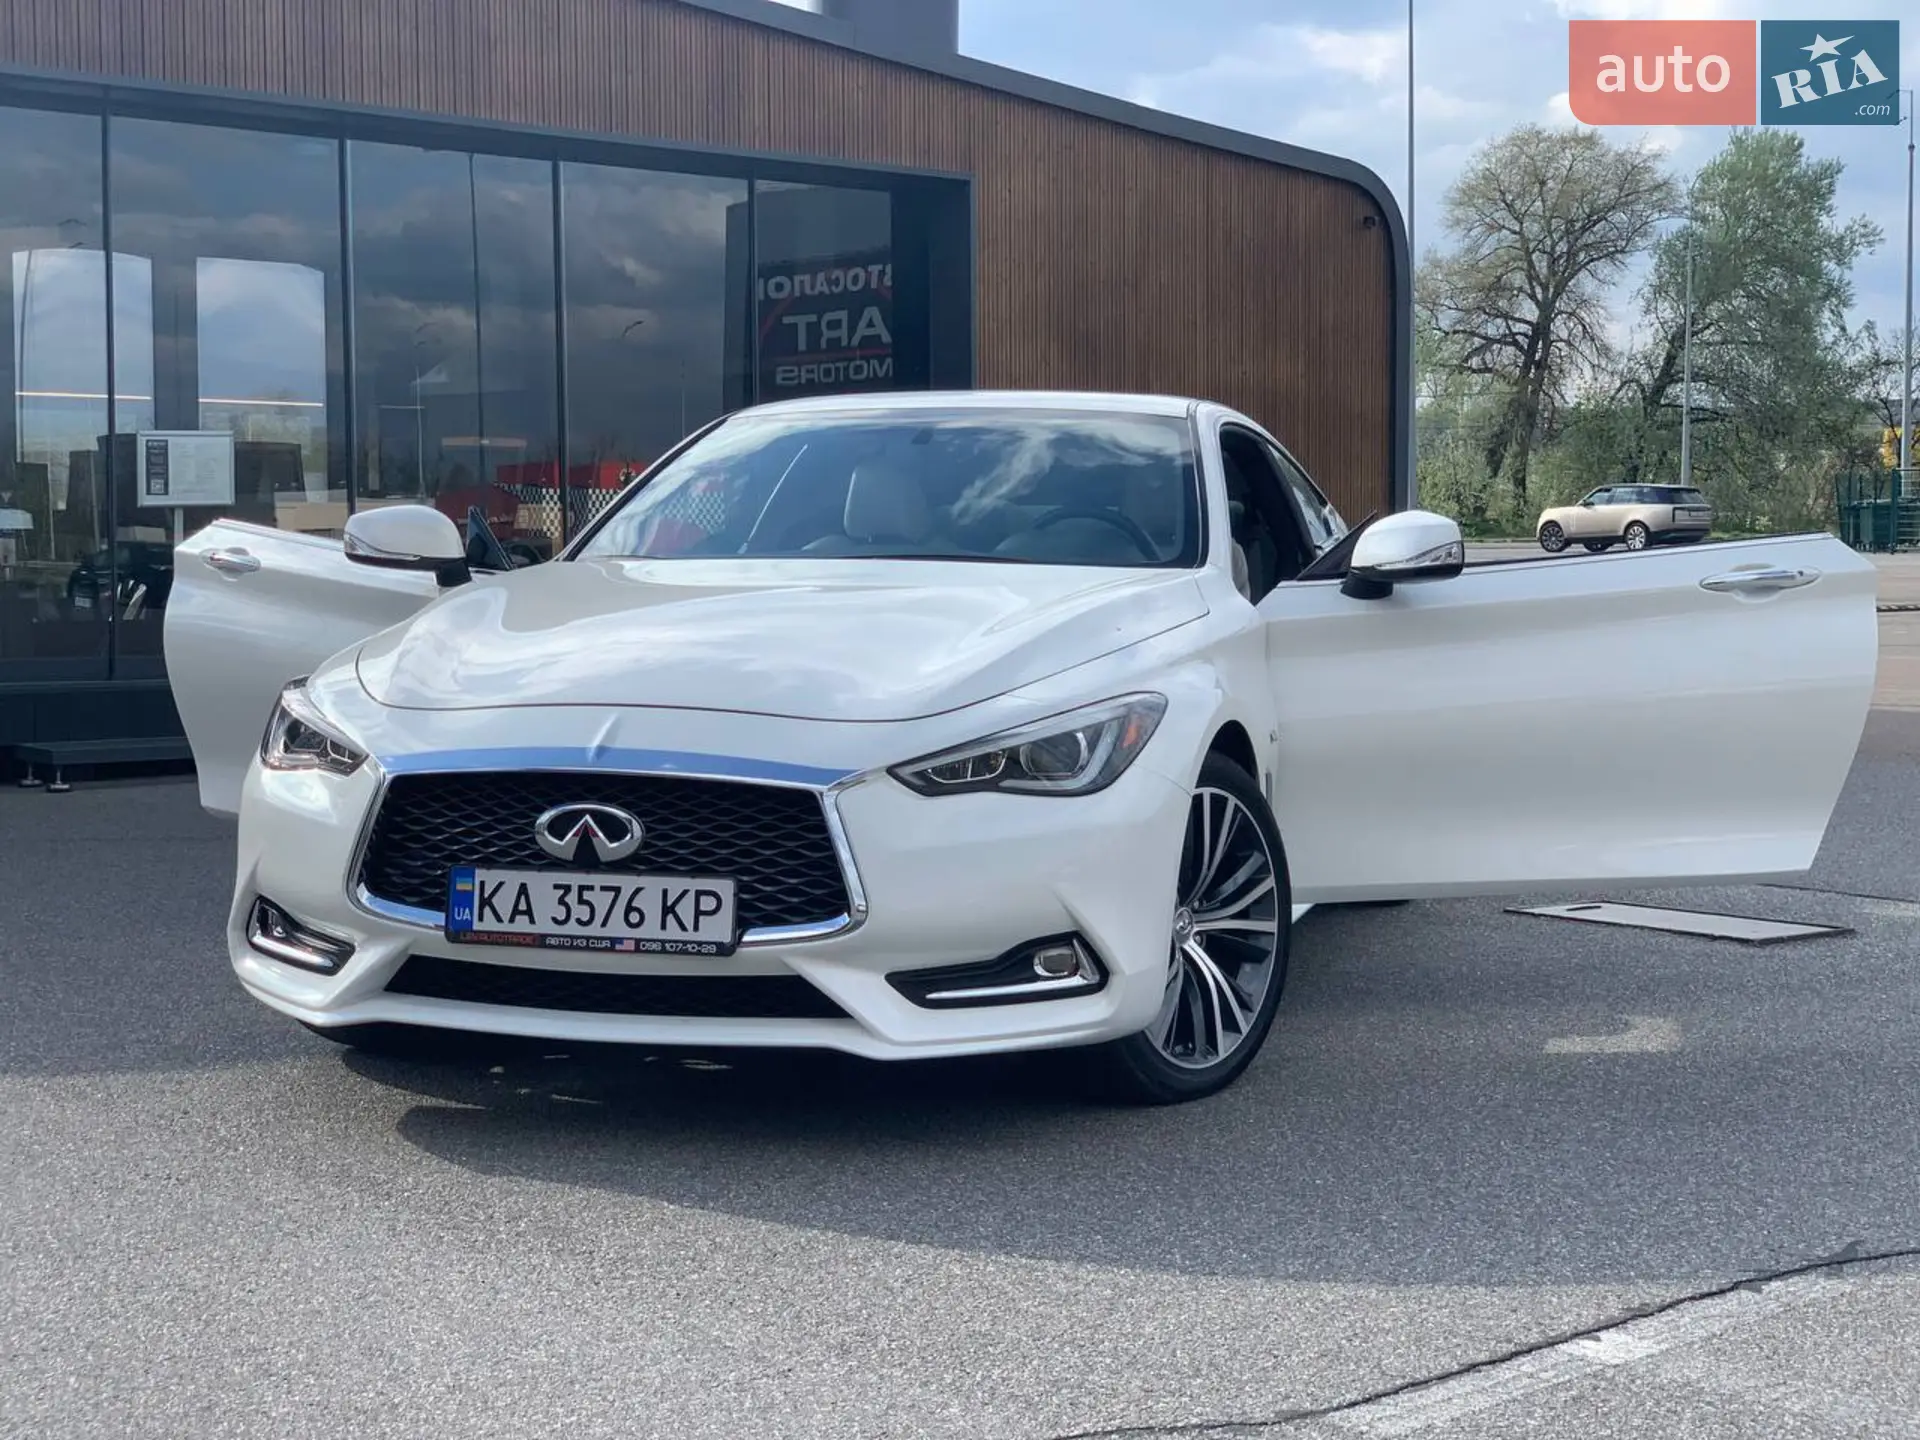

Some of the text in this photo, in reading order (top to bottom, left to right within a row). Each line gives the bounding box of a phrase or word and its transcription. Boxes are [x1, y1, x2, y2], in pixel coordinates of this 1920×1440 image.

[454, 906, 472, 921] UA
[477, 880, 723, 932] KA 3576 KP
[546, 937, 571, 946] АВТО
[573, 938, 587, 947] ИЗ
